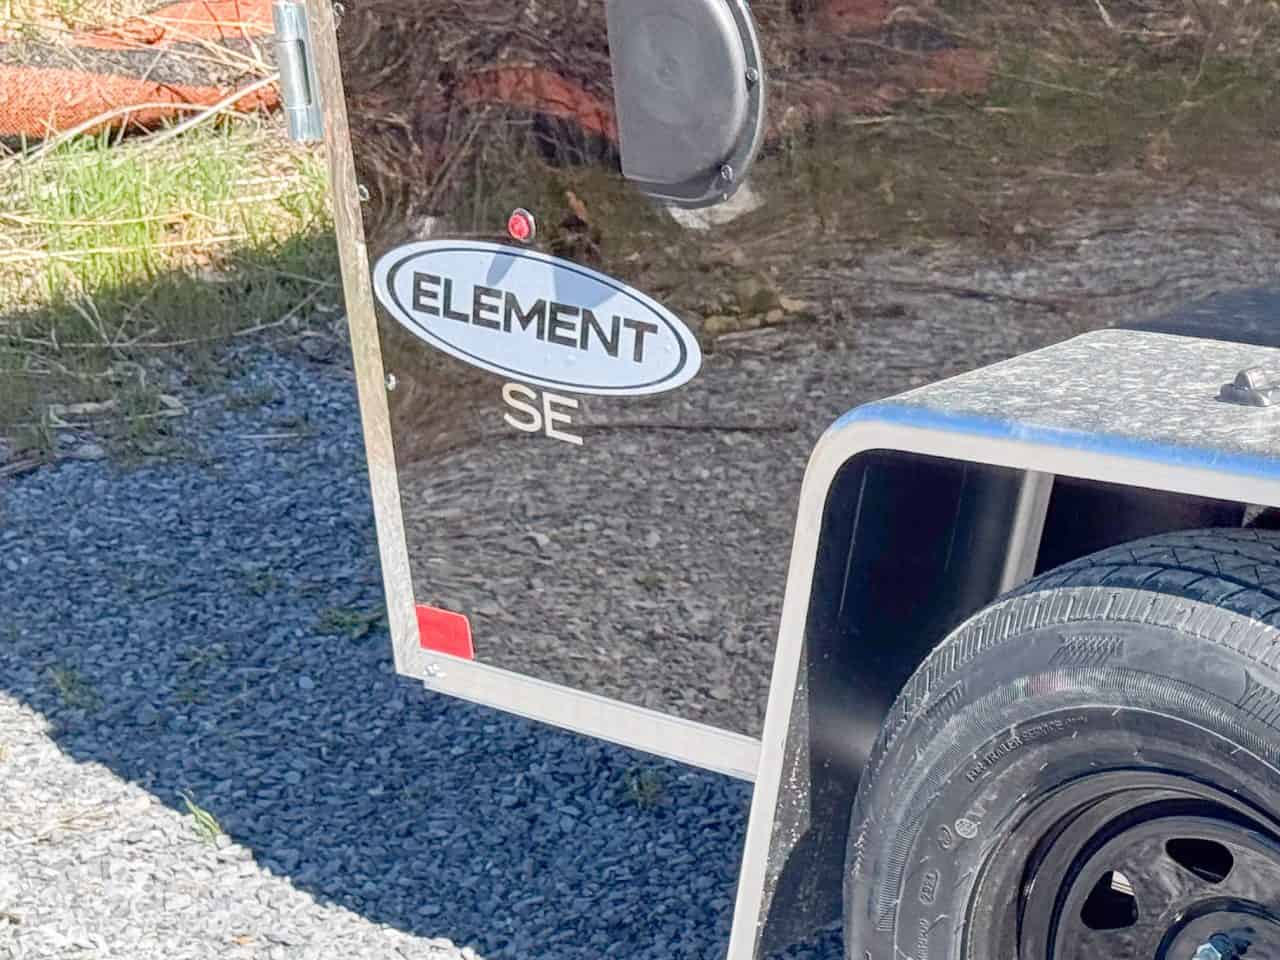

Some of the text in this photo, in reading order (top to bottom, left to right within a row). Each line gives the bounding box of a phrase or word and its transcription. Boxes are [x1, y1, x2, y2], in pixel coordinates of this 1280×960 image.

[412, 270, 659, 364] ELEMENT
[502, 382, 584, 446] SE
[986, 735, 1022, 766] TRAILER
